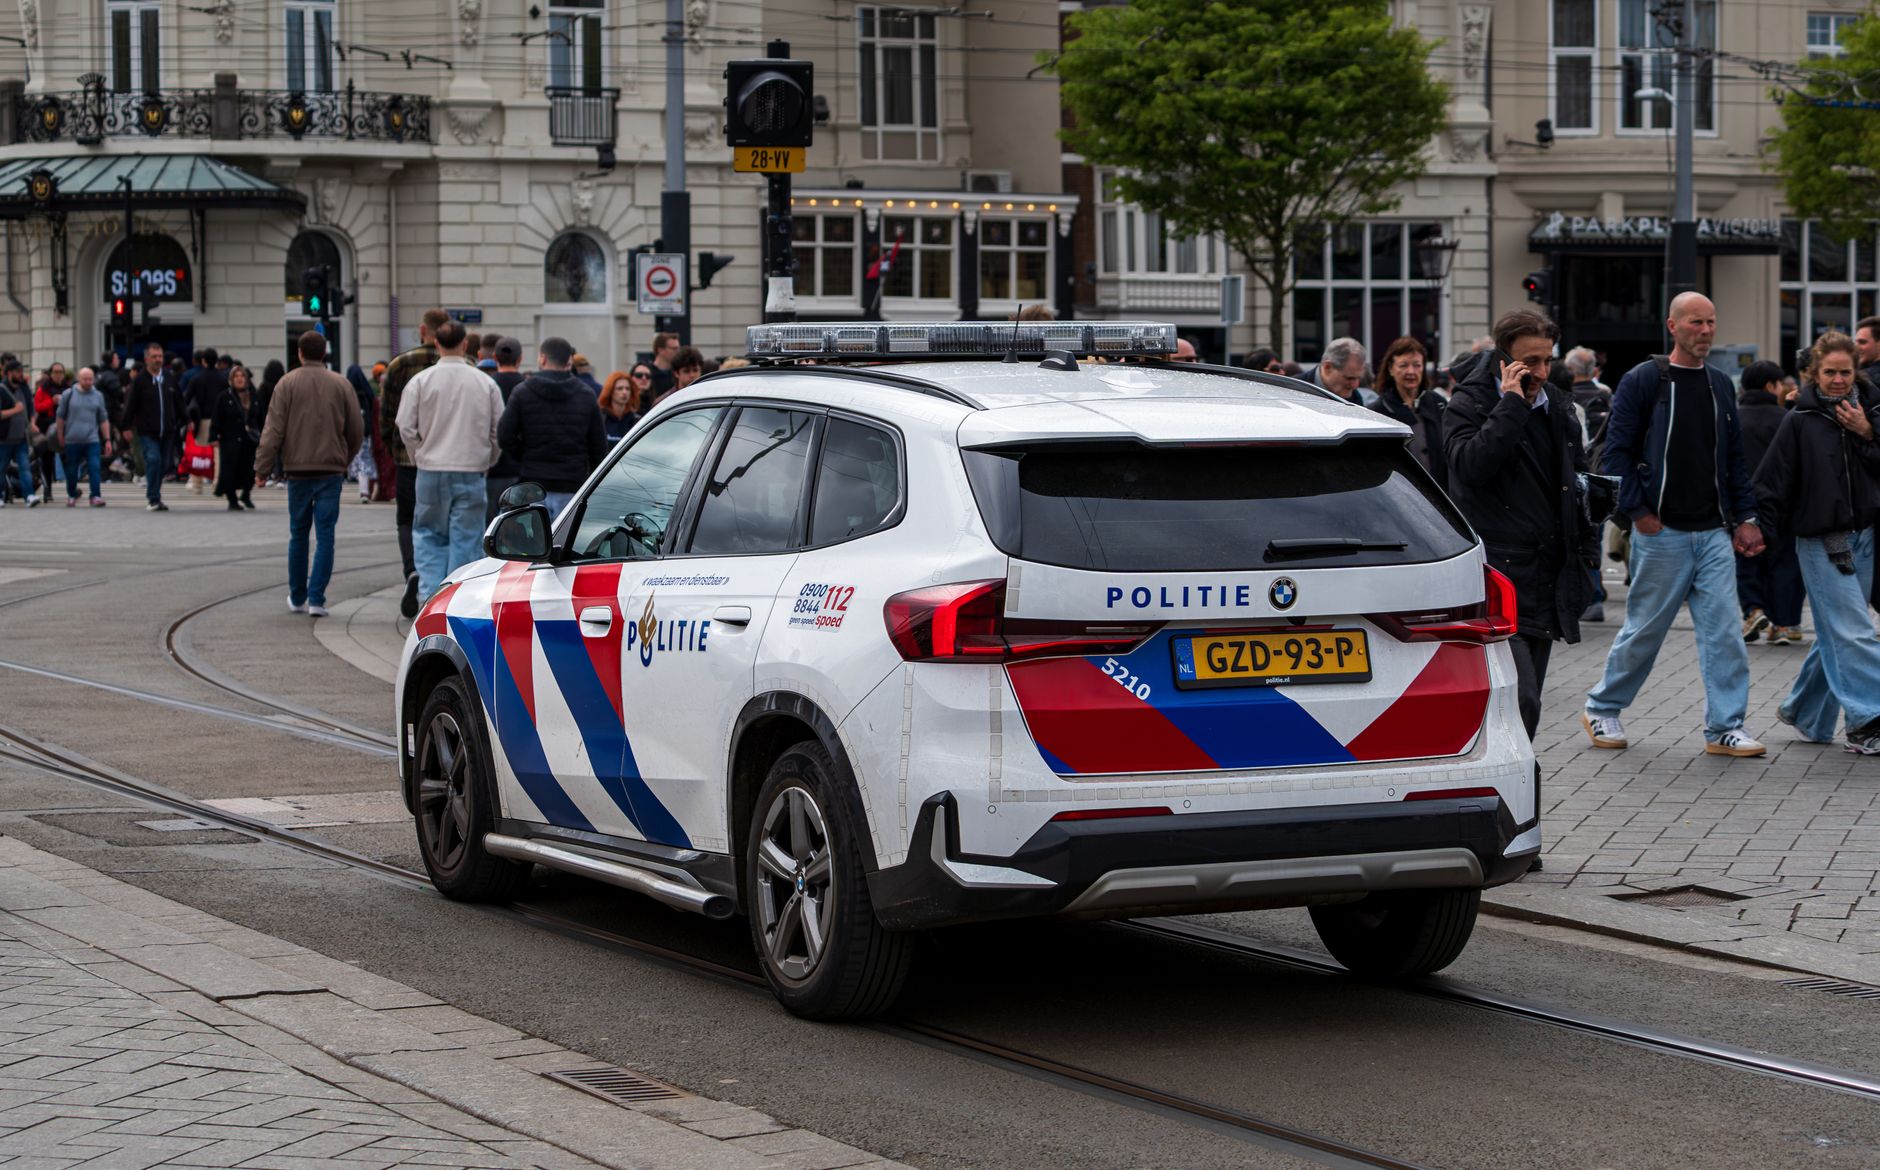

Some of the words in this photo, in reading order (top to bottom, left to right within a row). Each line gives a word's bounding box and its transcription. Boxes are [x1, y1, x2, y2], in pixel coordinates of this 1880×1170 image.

[751, 150, 790, 168] 28-VV
[800, 583, 829, 598] 0900
[823, 585, 855, 612] 112
[1107, 585, 1250, 608] POLITIE
[793, 598, 820, 614] 8844
[789, 617, 801, 625] geen
[800, 618, 815, 627] spoed
[815, 614, 844, 629] spoed
[628, 620, 711, 667] POLITIE
[1206, 637, 1354, 673] GZD-93-P
[1179, 663, 1194, 674] NL
[1101, 657, 1151, 700] 5210
[1265, 676, 1290, 684] politie.nl
